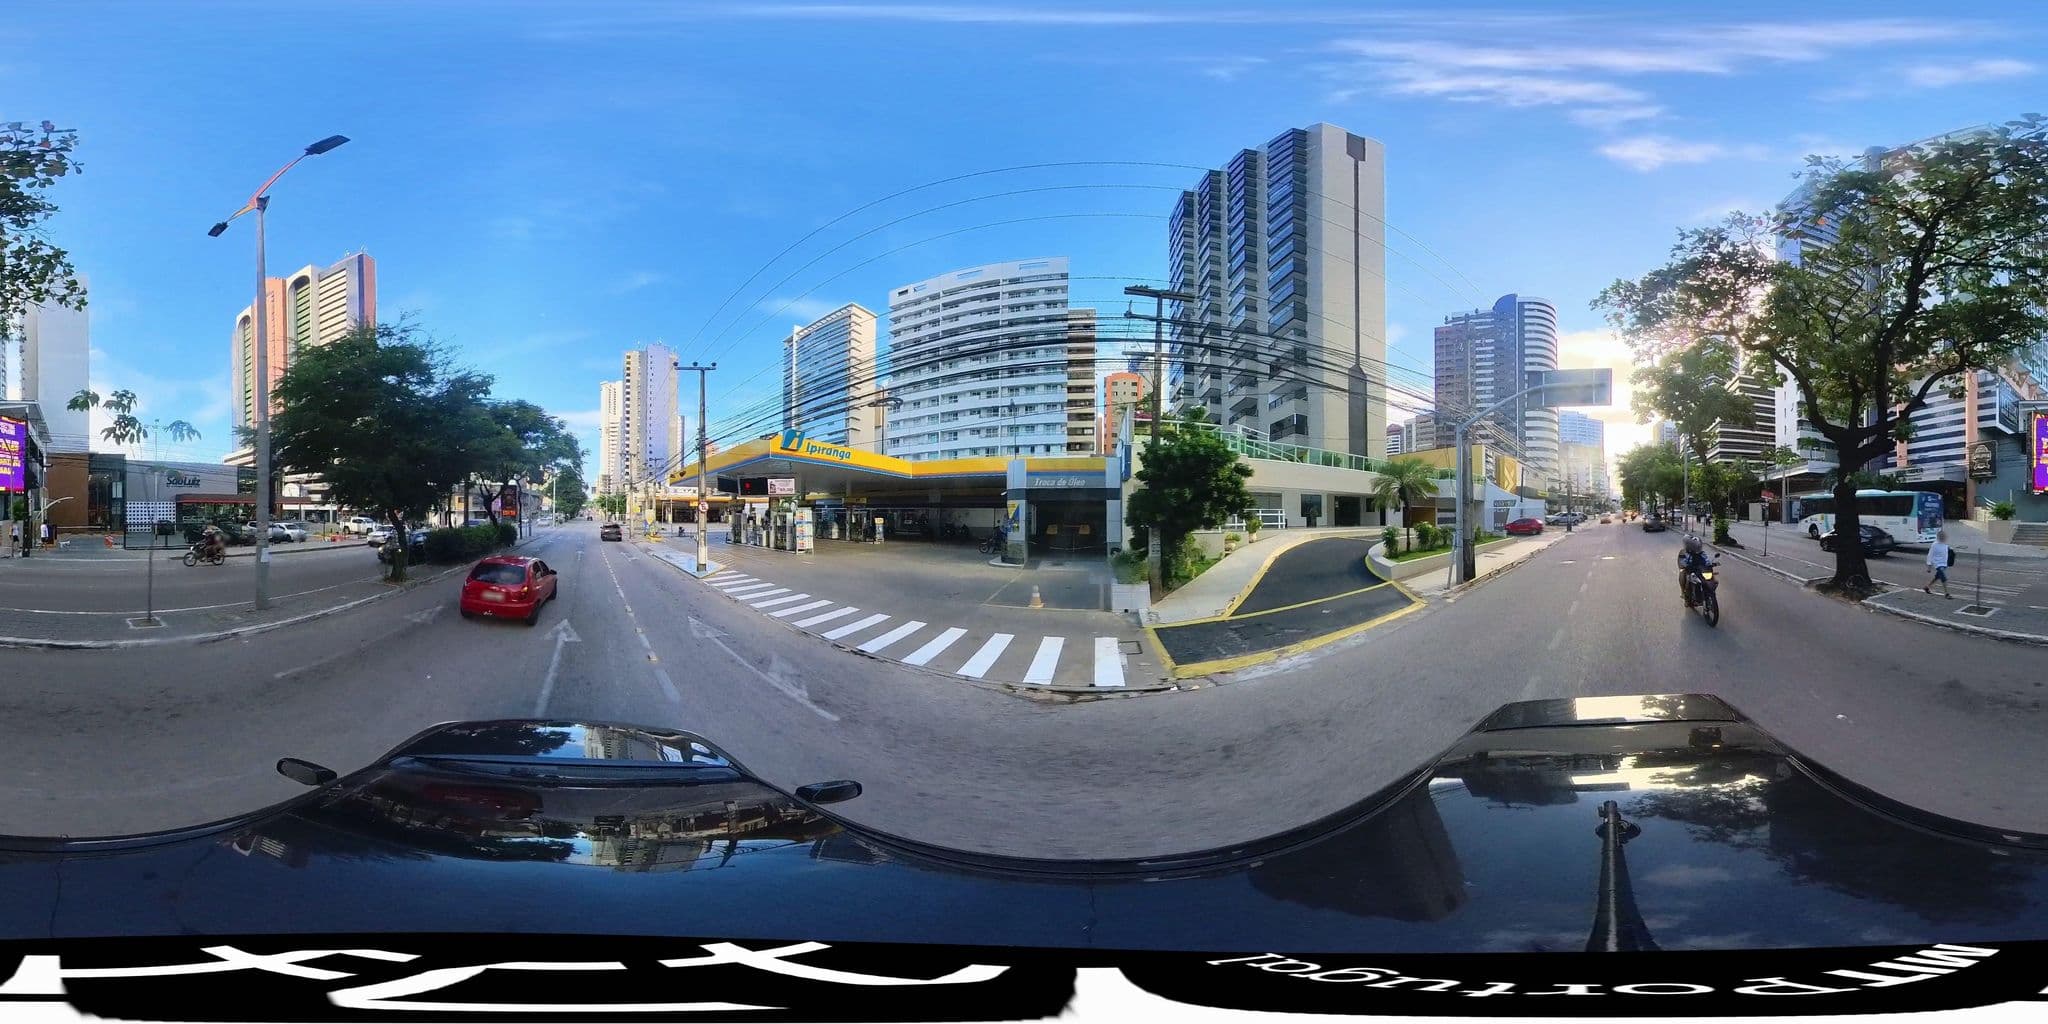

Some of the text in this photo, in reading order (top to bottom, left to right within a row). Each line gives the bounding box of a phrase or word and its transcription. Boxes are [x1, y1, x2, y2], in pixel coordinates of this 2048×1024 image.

[806, 442, 851, 460] Ipiranga
[1034, 477, 1056, 487] Troca
[1057, 478, 1067, 487] de
